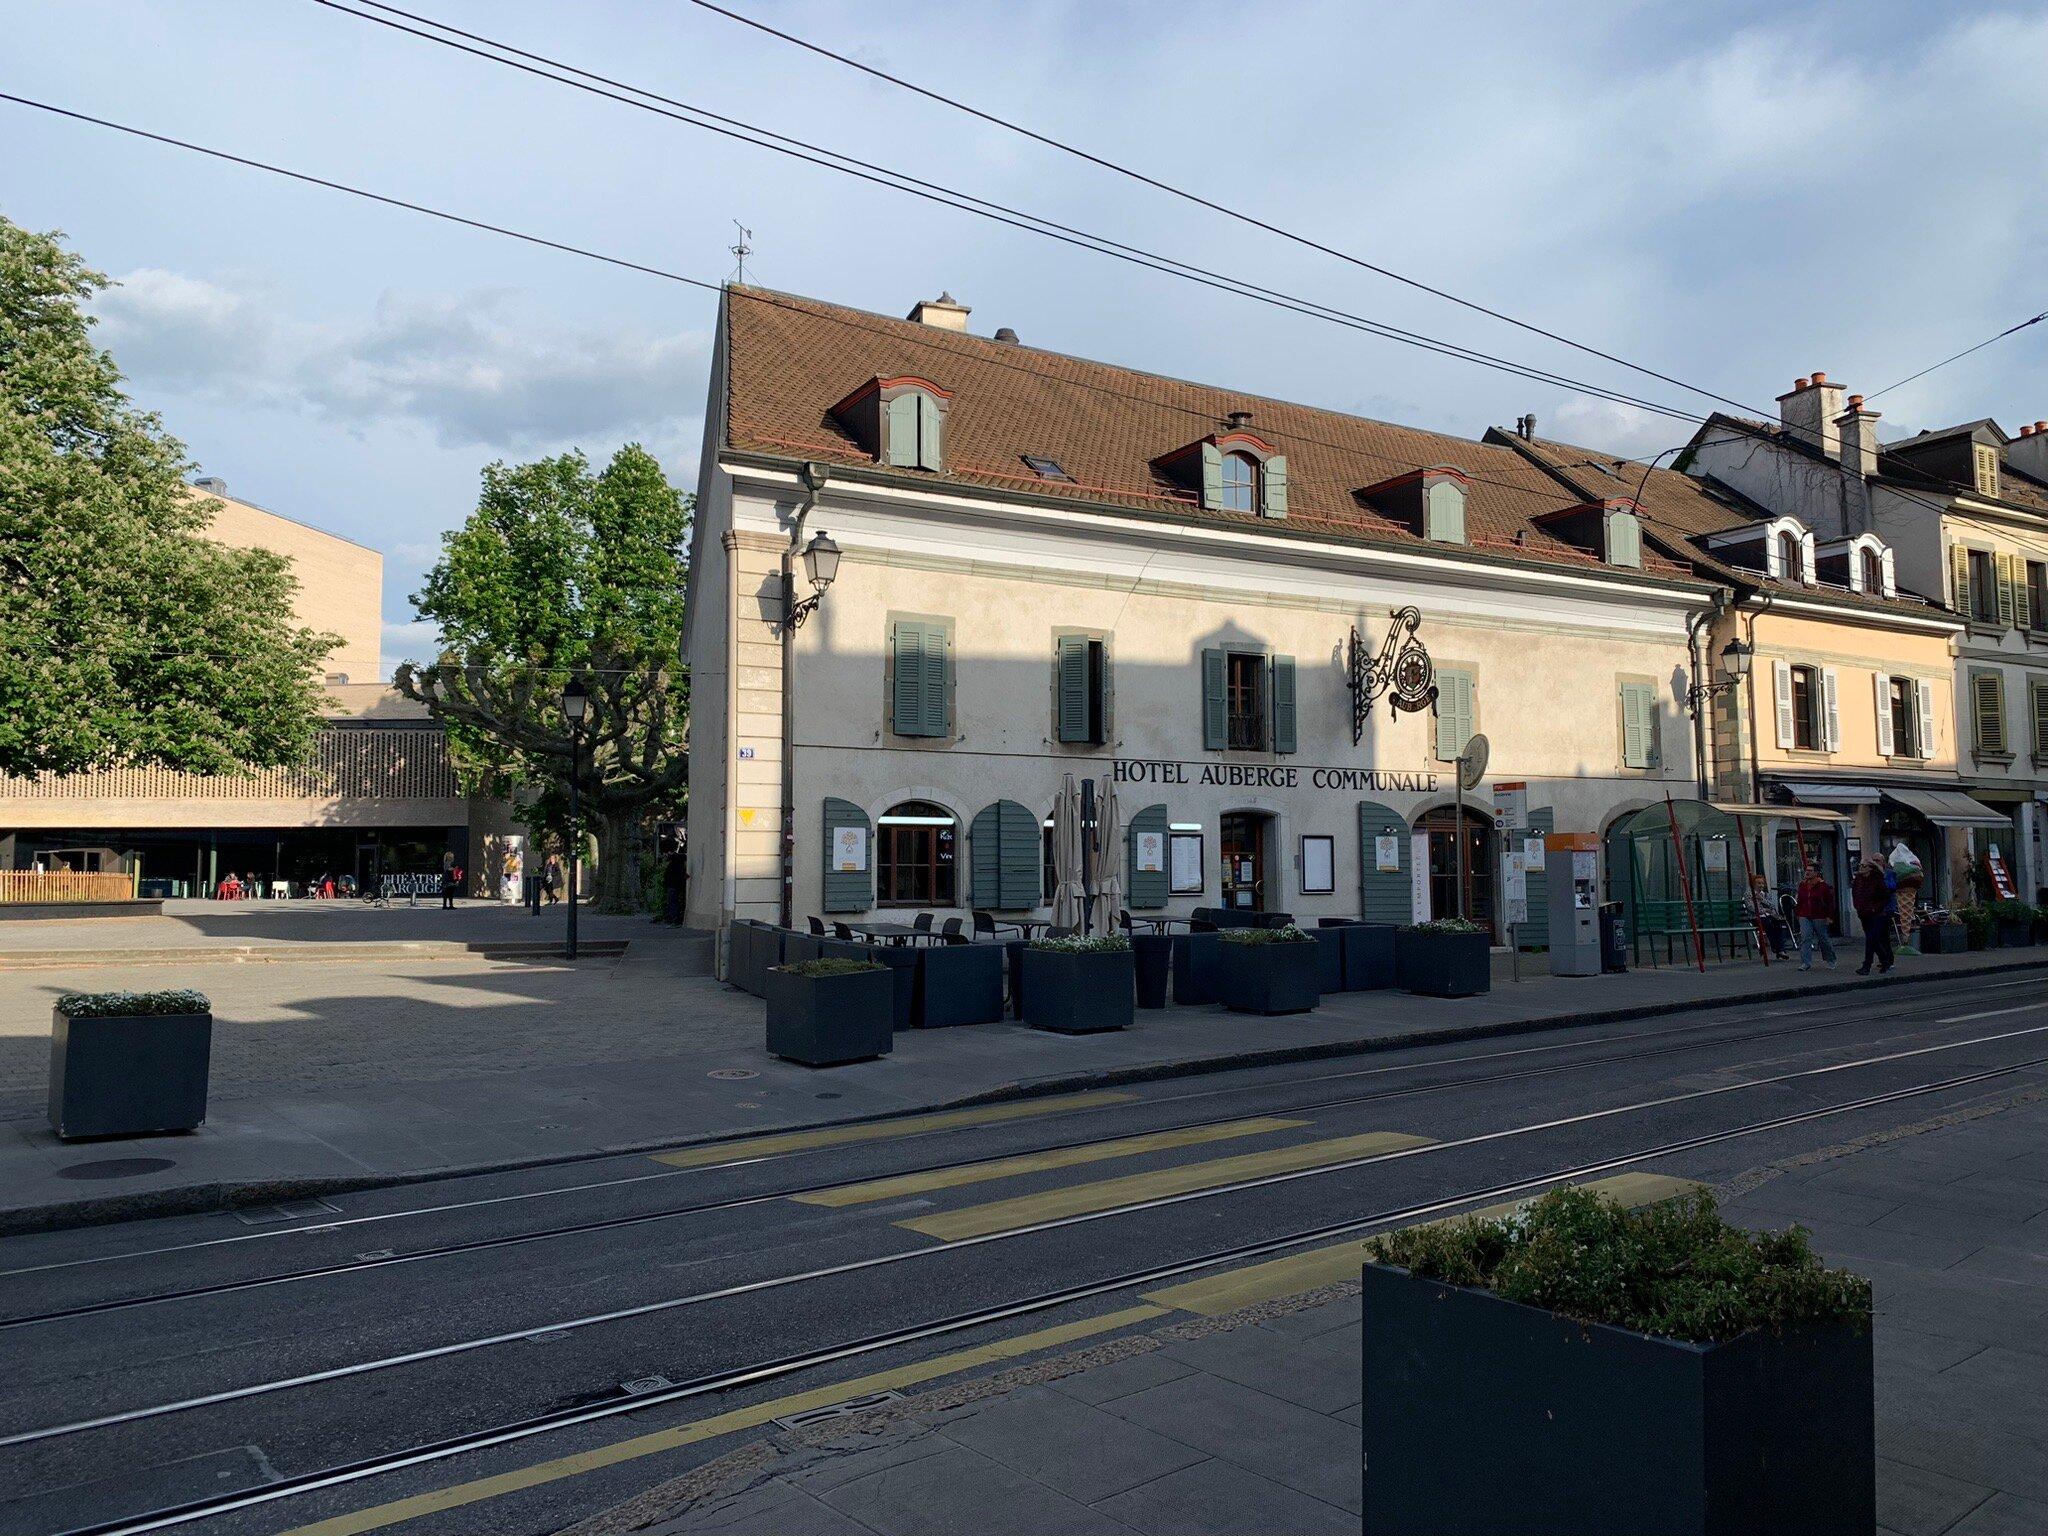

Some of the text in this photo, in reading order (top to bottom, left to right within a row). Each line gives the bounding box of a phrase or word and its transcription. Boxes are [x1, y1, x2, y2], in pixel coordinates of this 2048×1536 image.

[1112, 761, 1439, 793] HOTEL AUBERGE COMMUNALE
[381, 871, 443, 884] THÉÂTRE
[381, 883, 443, 894] AROUGE
